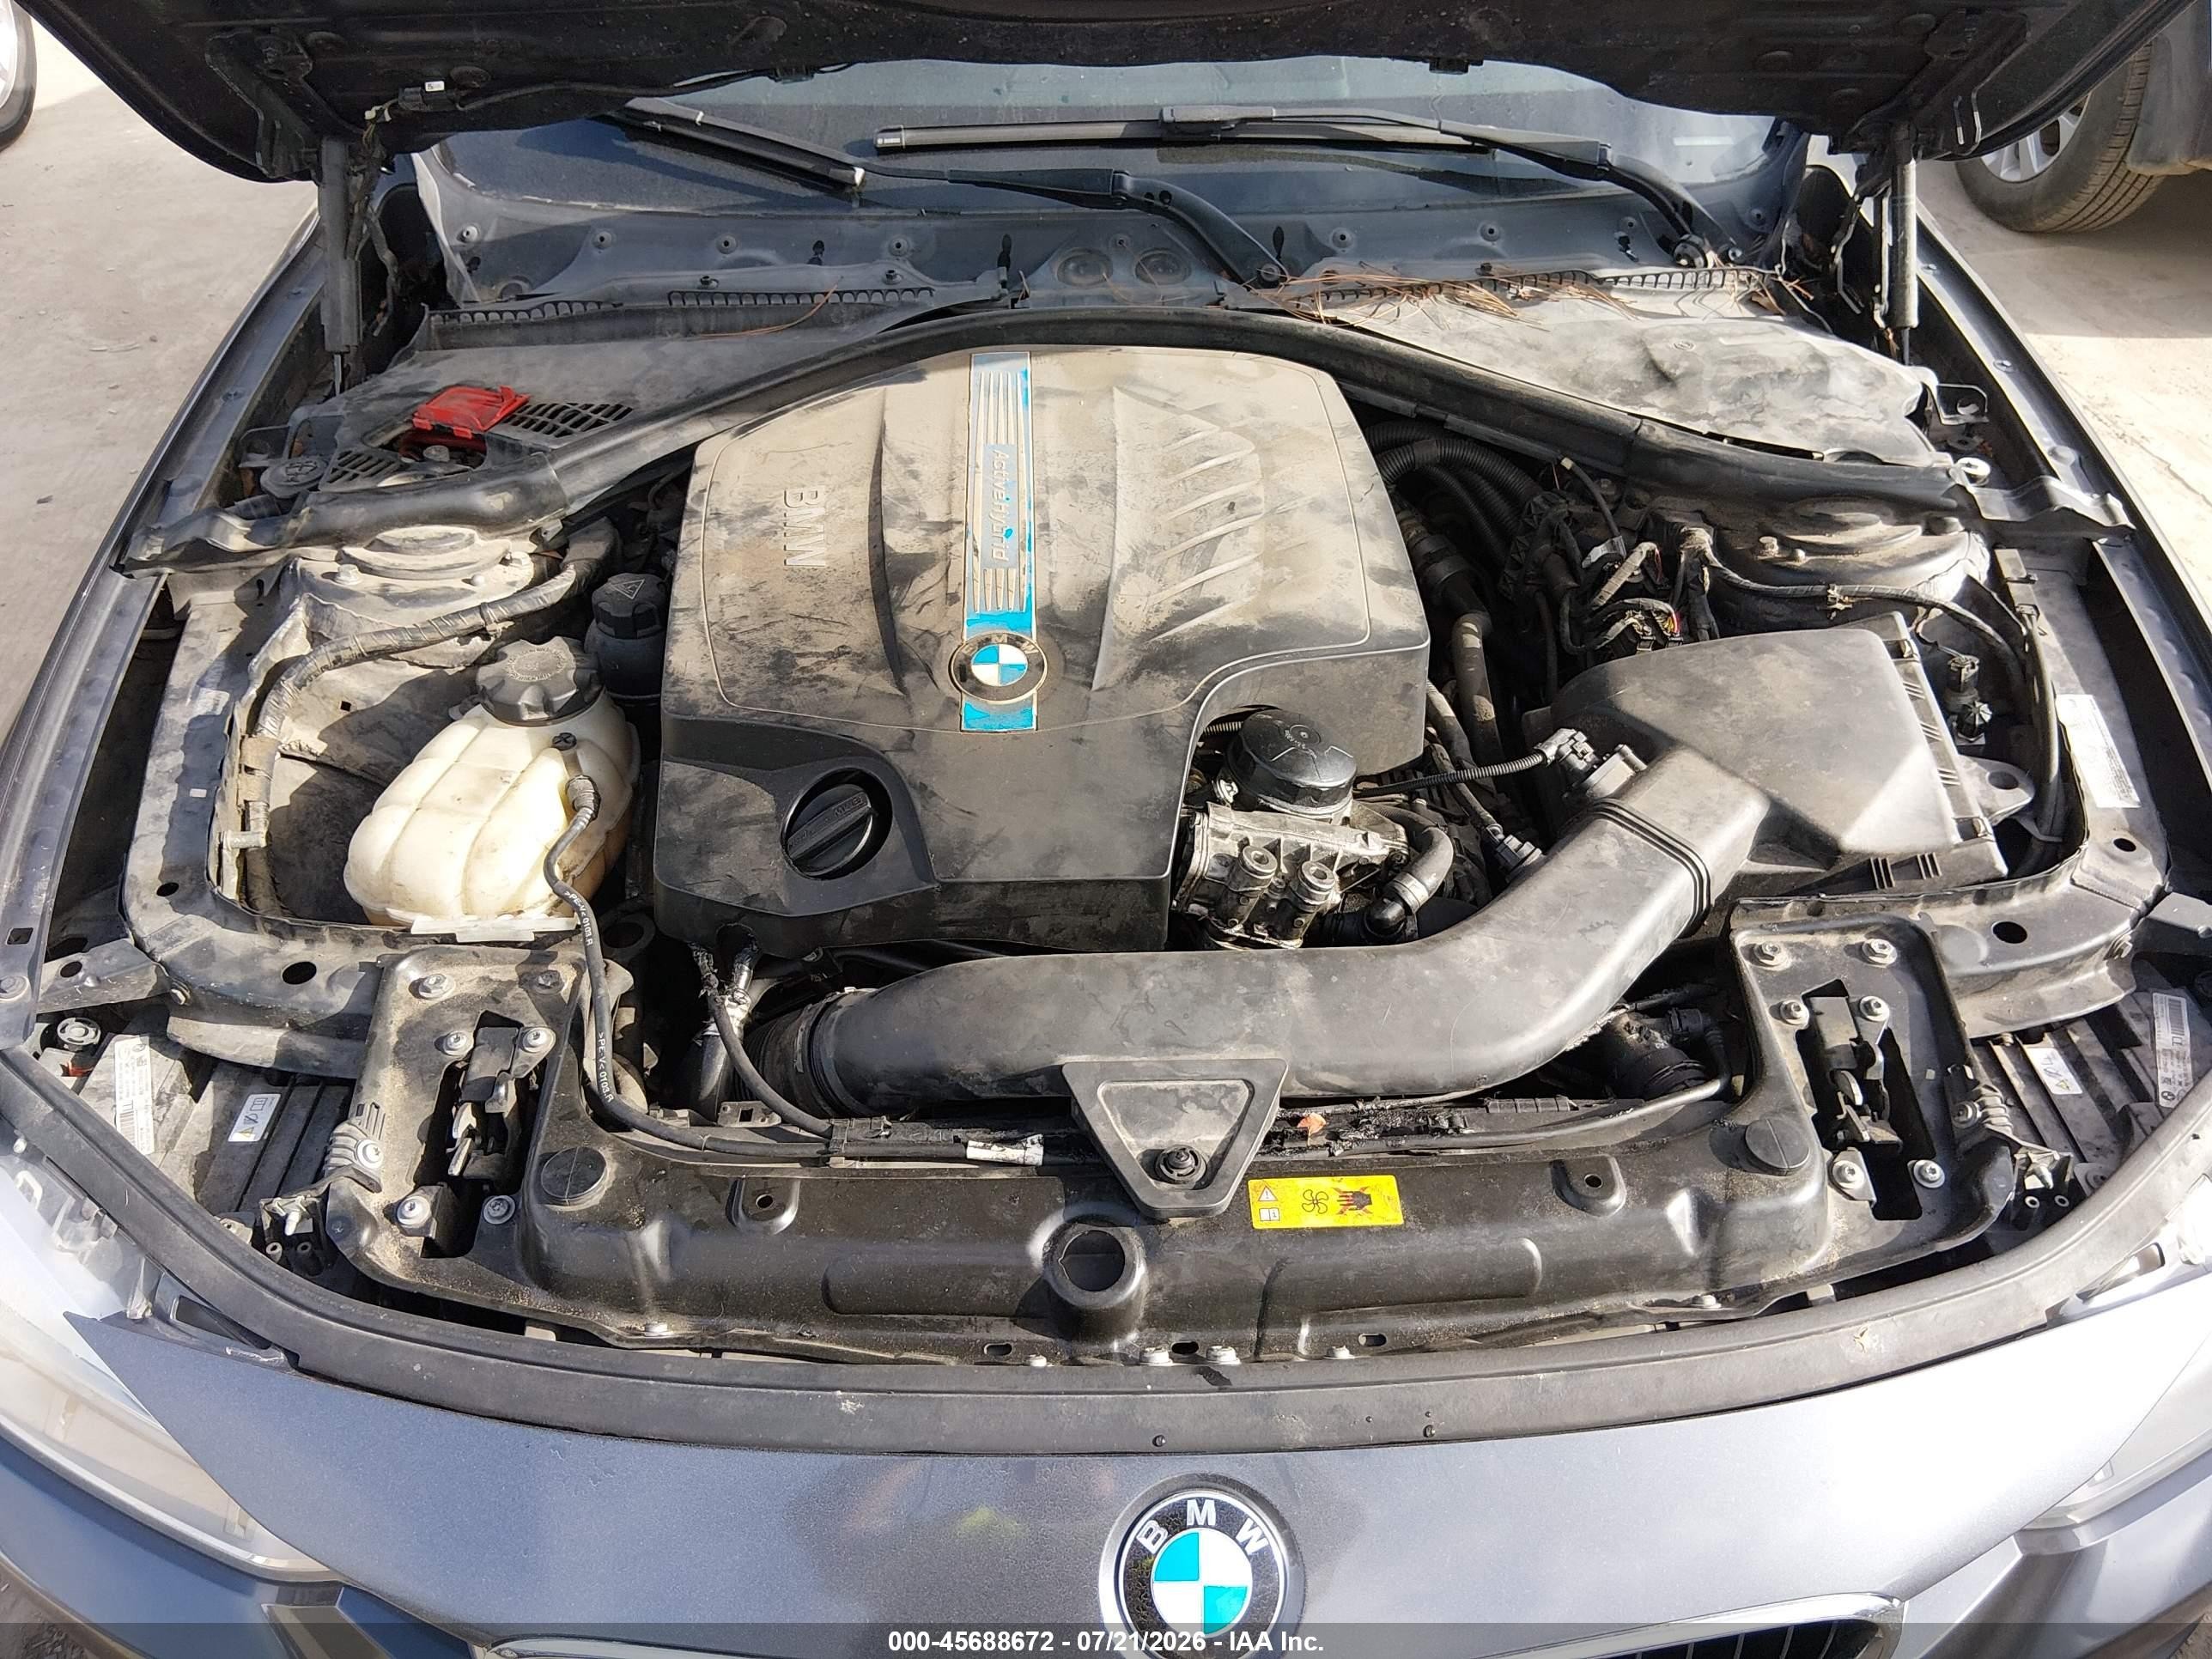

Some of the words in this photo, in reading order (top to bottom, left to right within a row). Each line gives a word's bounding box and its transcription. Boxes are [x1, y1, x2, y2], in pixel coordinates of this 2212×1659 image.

[782, 486, 826, 567] BMW
[989, 449, 1010, 562] ActiveHybrid
[1135, 1498, 1269, 1555] BMW
